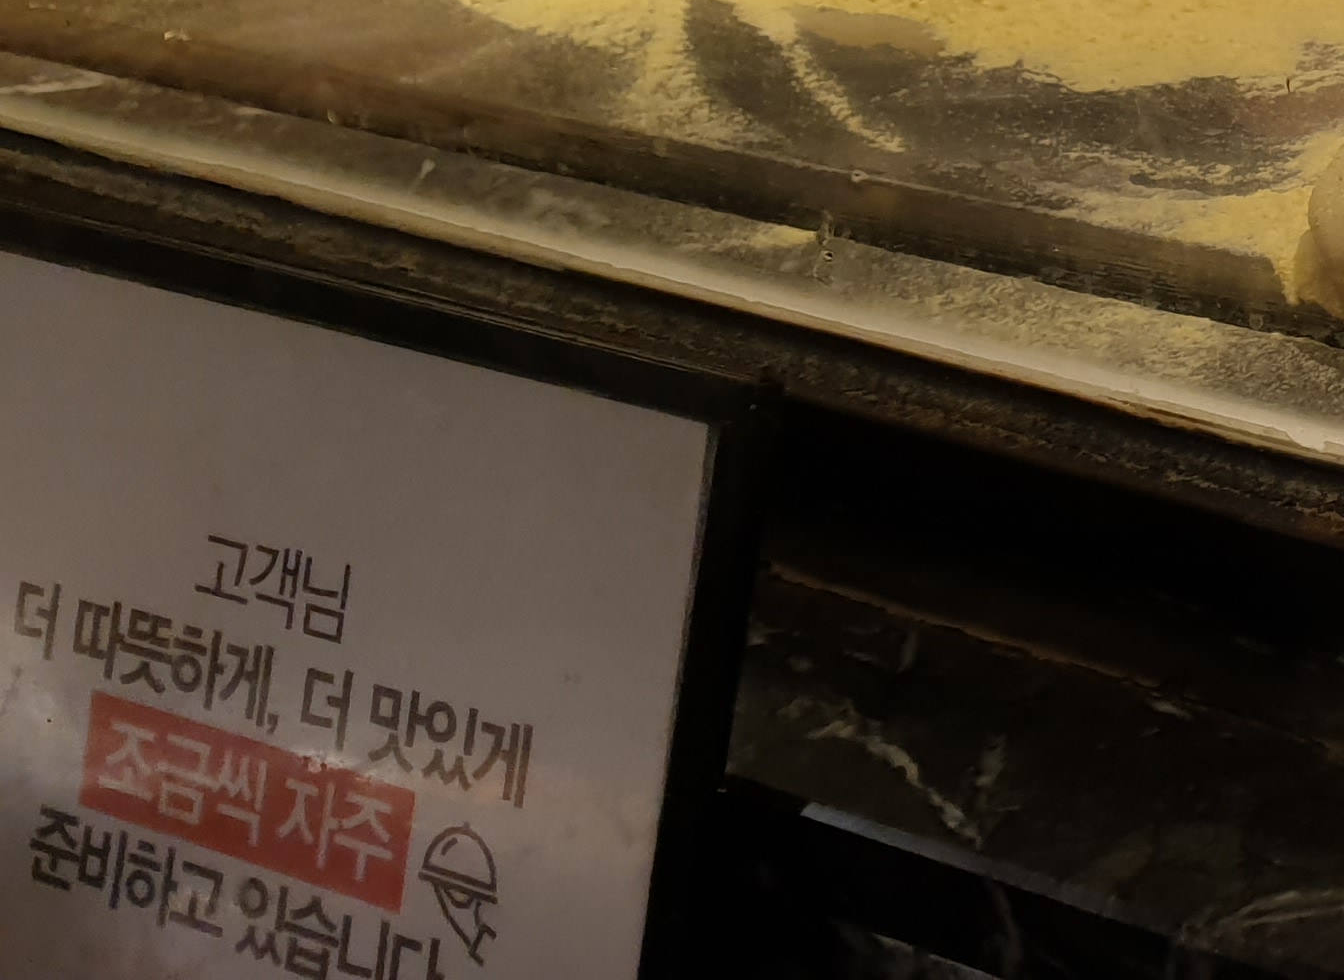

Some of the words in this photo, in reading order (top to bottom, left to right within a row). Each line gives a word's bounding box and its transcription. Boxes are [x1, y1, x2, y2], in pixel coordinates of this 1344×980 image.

[195, 534, 351, 644] 고객님
[14, 581, 61, 660] 더
[73, 599, 279, 733] 따뜻하게,
[301, 668, 354, 752] 더
[368, 683, 534, 808] 맛있게
[29, 804, 224, 938] 준비하고
[99, 720, 269, 847] 조금씩
[278, 776, 395, 882] 자주
